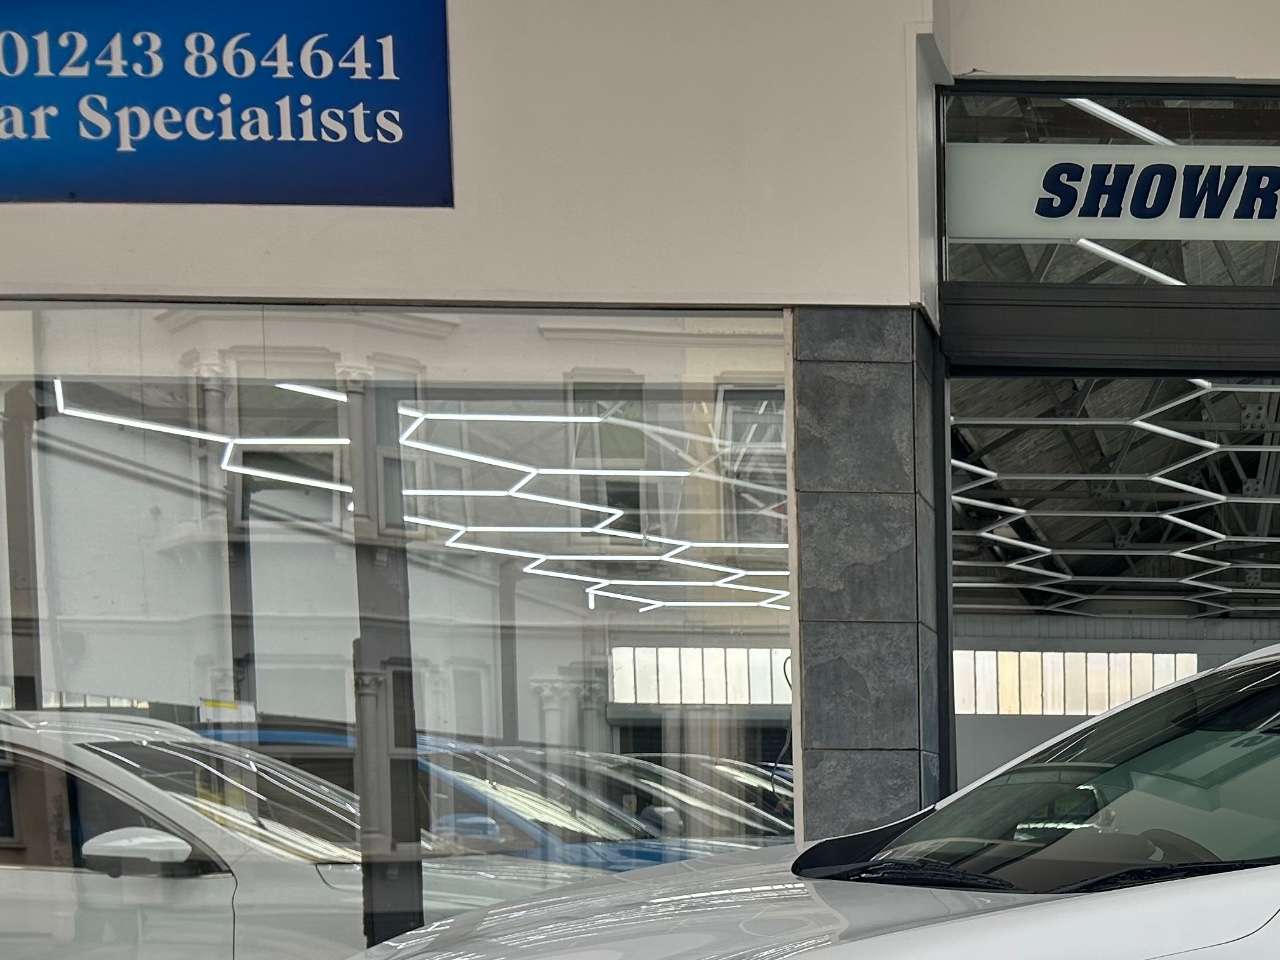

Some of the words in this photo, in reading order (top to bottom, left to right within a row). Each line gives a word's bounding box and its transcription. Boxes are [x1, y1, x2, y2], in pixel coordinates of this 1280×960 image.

[0, 30, 163, 78] 01243
[184, 31, 401, 80] 864641
[78, 93, 404, 152] Specialists
